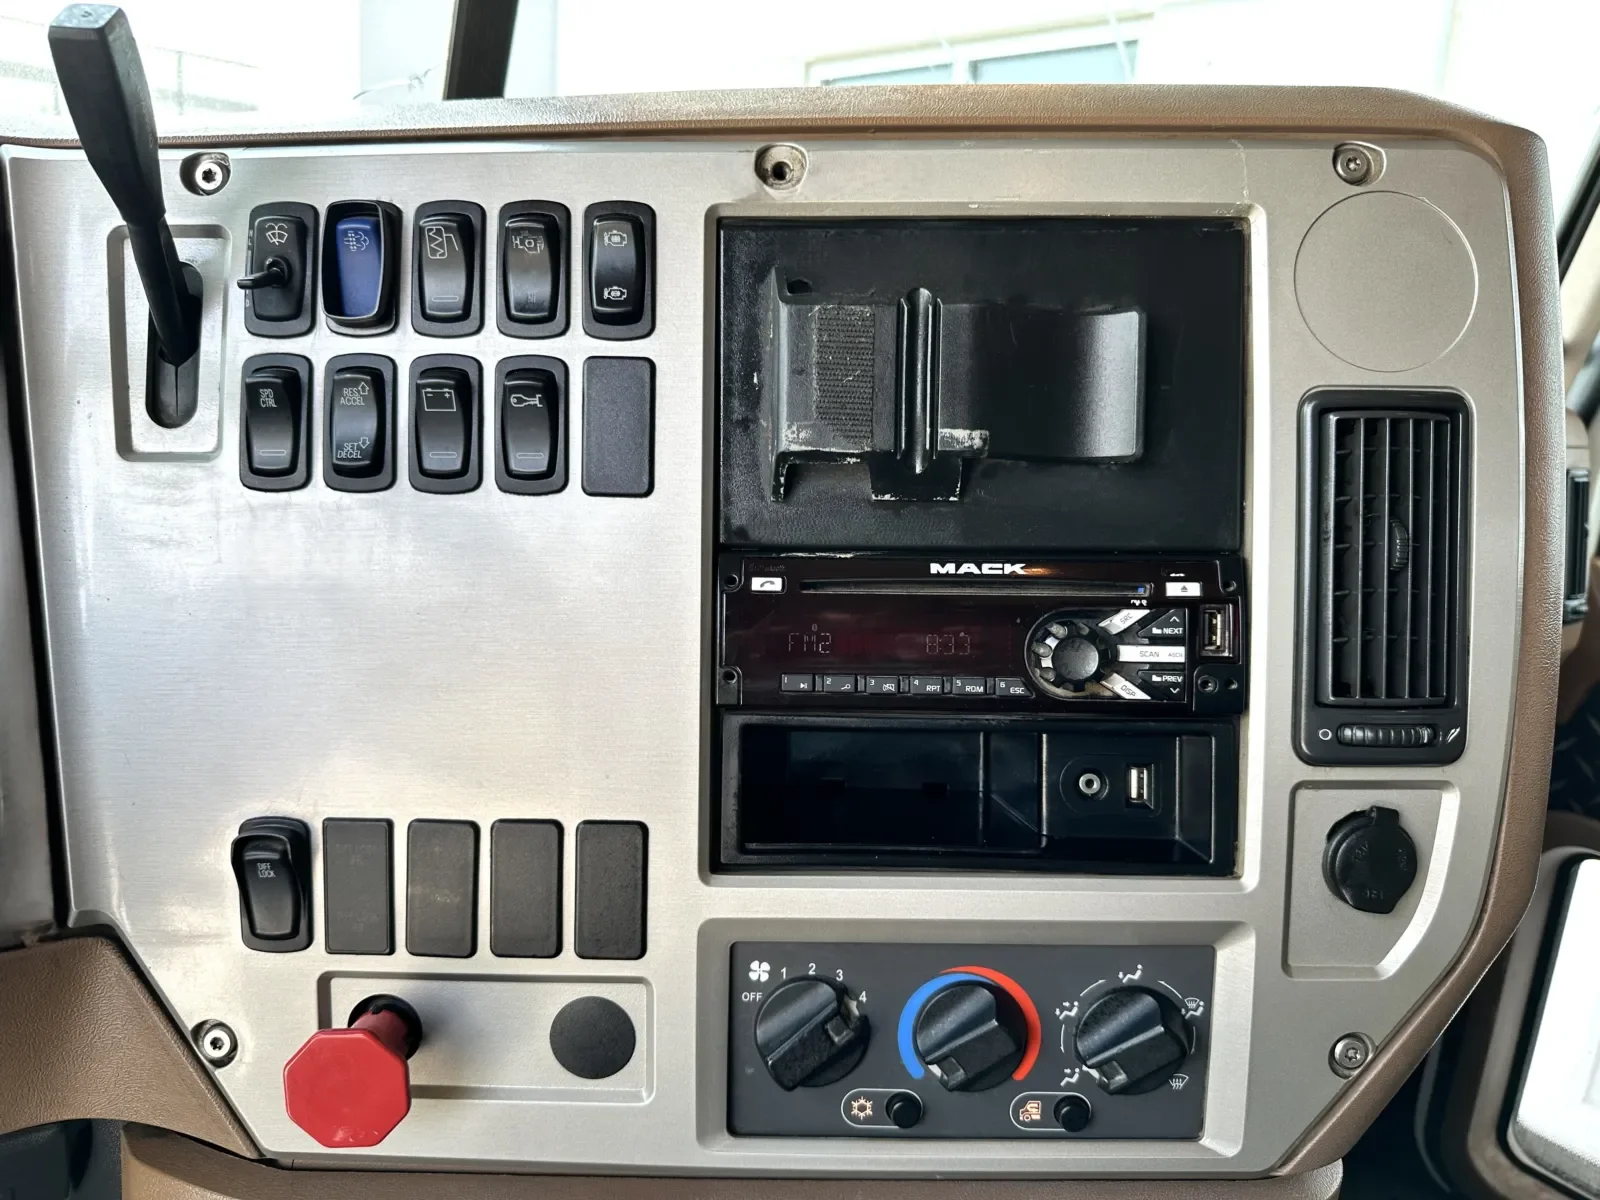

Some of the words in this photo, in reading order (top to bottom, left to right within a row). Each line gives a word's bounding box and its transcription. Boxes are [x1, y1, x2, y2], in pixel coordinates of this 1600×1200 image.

[259, 388, 274, 398] SPD
[260, 398, 278, 408] CTRL
[339, 396, 366, 406] ACCEL
[343, 442, 359, 451] SET
[337, 450, 362, 459] DECEL
[929, 562, 1027, 575] MACK
[1119, 612, 1133, 625] SRC
[788, 632, 832, 654] FM2
[1139, 650, 1160, 658] SCAN
[784, 676, 788, 684] 1
[826, 677, 832, 685] 2
[956, 679, 962, 687] 5
[965, 685, 984, 693] RDM
[1120, 684, 1136, 697] DISP
[257, 862, 271, 870] DIFF
[258, 869, 277, 879] LOCK
[780, 967, 787, 979] 1
[808, 962, 816, 975] 2
[835, 969, 844, 981] 3
[741, 991, 763, 1002] OFF
[858, 990, 867, 1003] 4
